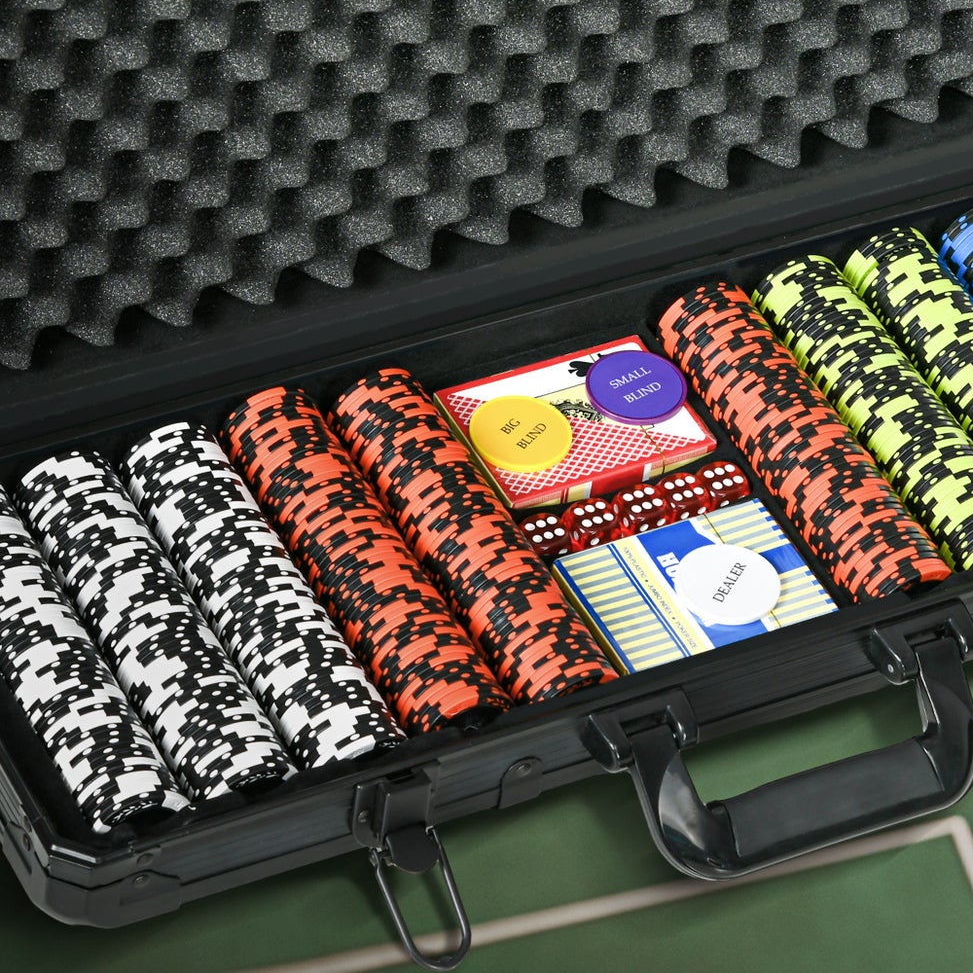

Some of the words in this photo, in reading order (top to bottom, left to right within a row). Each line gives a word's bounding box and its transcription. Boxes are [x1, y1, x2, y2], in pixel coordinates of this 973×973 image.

[609, 366, 652, 389] SMALL
[623, 381, 662, 403] BLIND
[500, 418, 521, 435] BIG
[516, 422, 547, 449] BLIND
[712, 562, 747, 603] DEALER
[647, 583, 663, 601] JUMBO
[658, 598, 672, 615] INDEX
[675, 621, 690, 639] POKER
